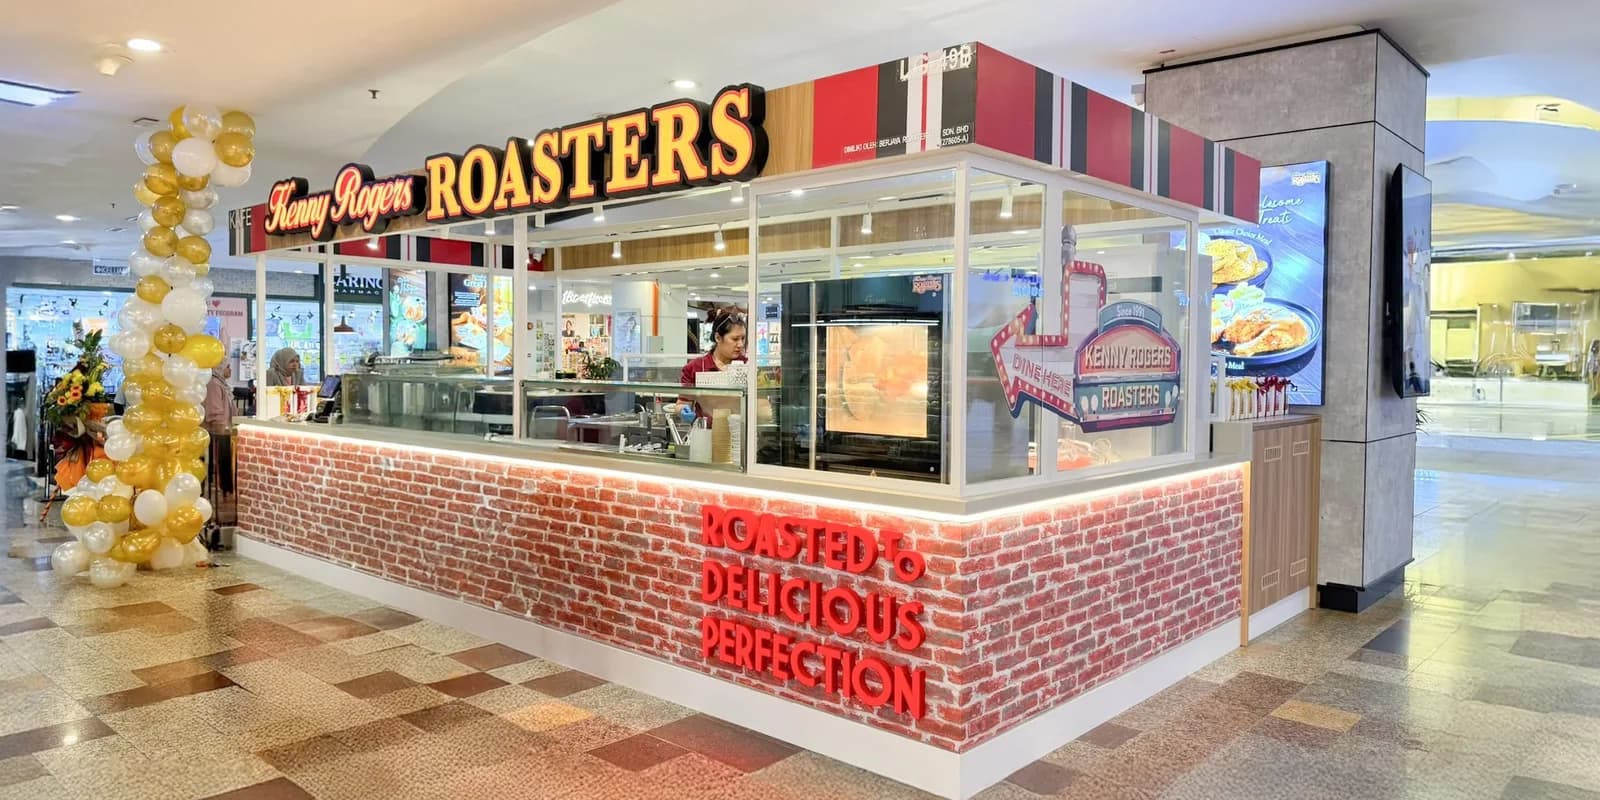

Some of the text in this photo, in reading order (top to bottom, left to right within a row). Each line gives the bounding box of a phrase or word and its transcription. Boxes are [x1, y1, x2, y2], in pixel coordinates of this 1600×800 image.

[878, 136, 901, 148] BERJAYA
[265, 87, 753, 240] Kenny Rogers ROASTERS
[333, 276, 383, 289] ARIN
[1117, 303, 1145, 318] Since 1991
[1013, 353, 1072, 397] DINE HERE
[1086, 345, 1172, 370] KENNY ROGERS
[1102, 384, 1160, 410] ROASTERS
[702, 505, 879, 574] ROASTED
[702, 560, 926, 650] DELICIOUS
[702, 616, 926, 720] PERFECTION
